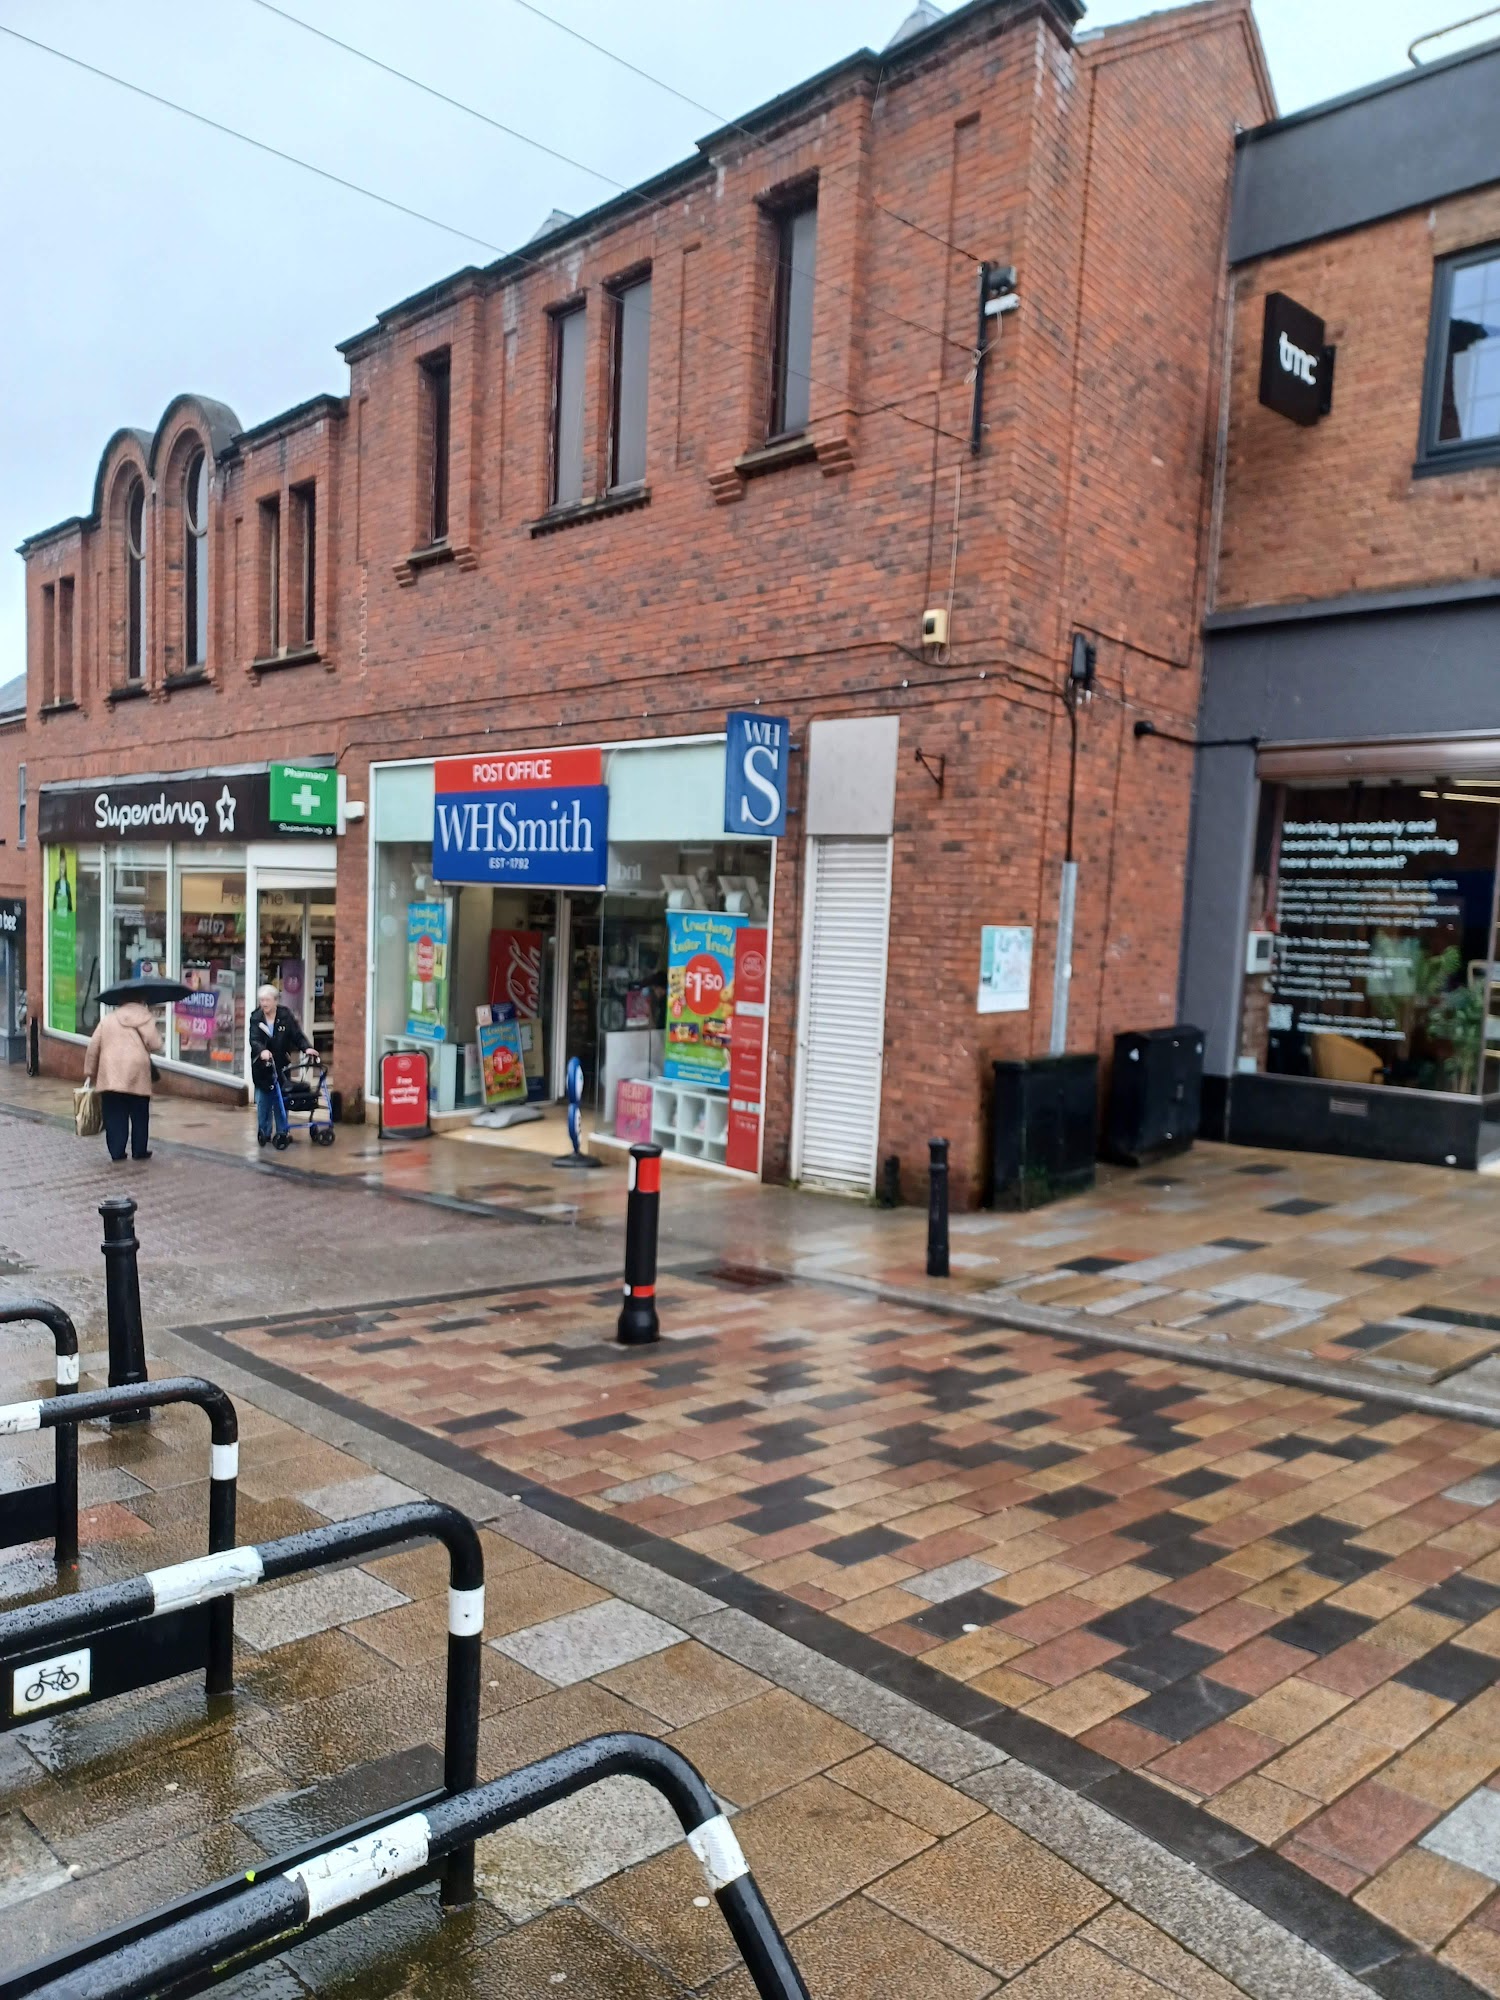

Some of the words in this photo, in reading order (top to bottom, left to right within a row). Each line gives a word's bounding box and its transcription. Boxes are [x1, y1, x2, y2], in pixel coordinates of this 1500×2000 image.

[1278, 330, 1318, 385] tmc
[743, 719, 782, 747] WH
[283, 767, 329, 783] Pharmacy
[473, 762, 505, 783] POST
[505, 759, 552, 781] OFFICE
[741, 744, 781, 827] S
[94, 792, 209, 836] Superdrug
[437, 800, 594, 853] WHSmith
[1282, 820, 1340, 838] Working
[1340, 819, 1405, 837] remotely
[1405, 818, 1438, 834] and
[1281, 837, 1349, 855] searching
[1350, 836, 1370, 852] for
[1371, 838, 1392, 852] an
[1392, 836, 1459, 856] inspiring
[1309, 854, 1408, 870] environment?
[192, 1018, 208, 1035] £20
